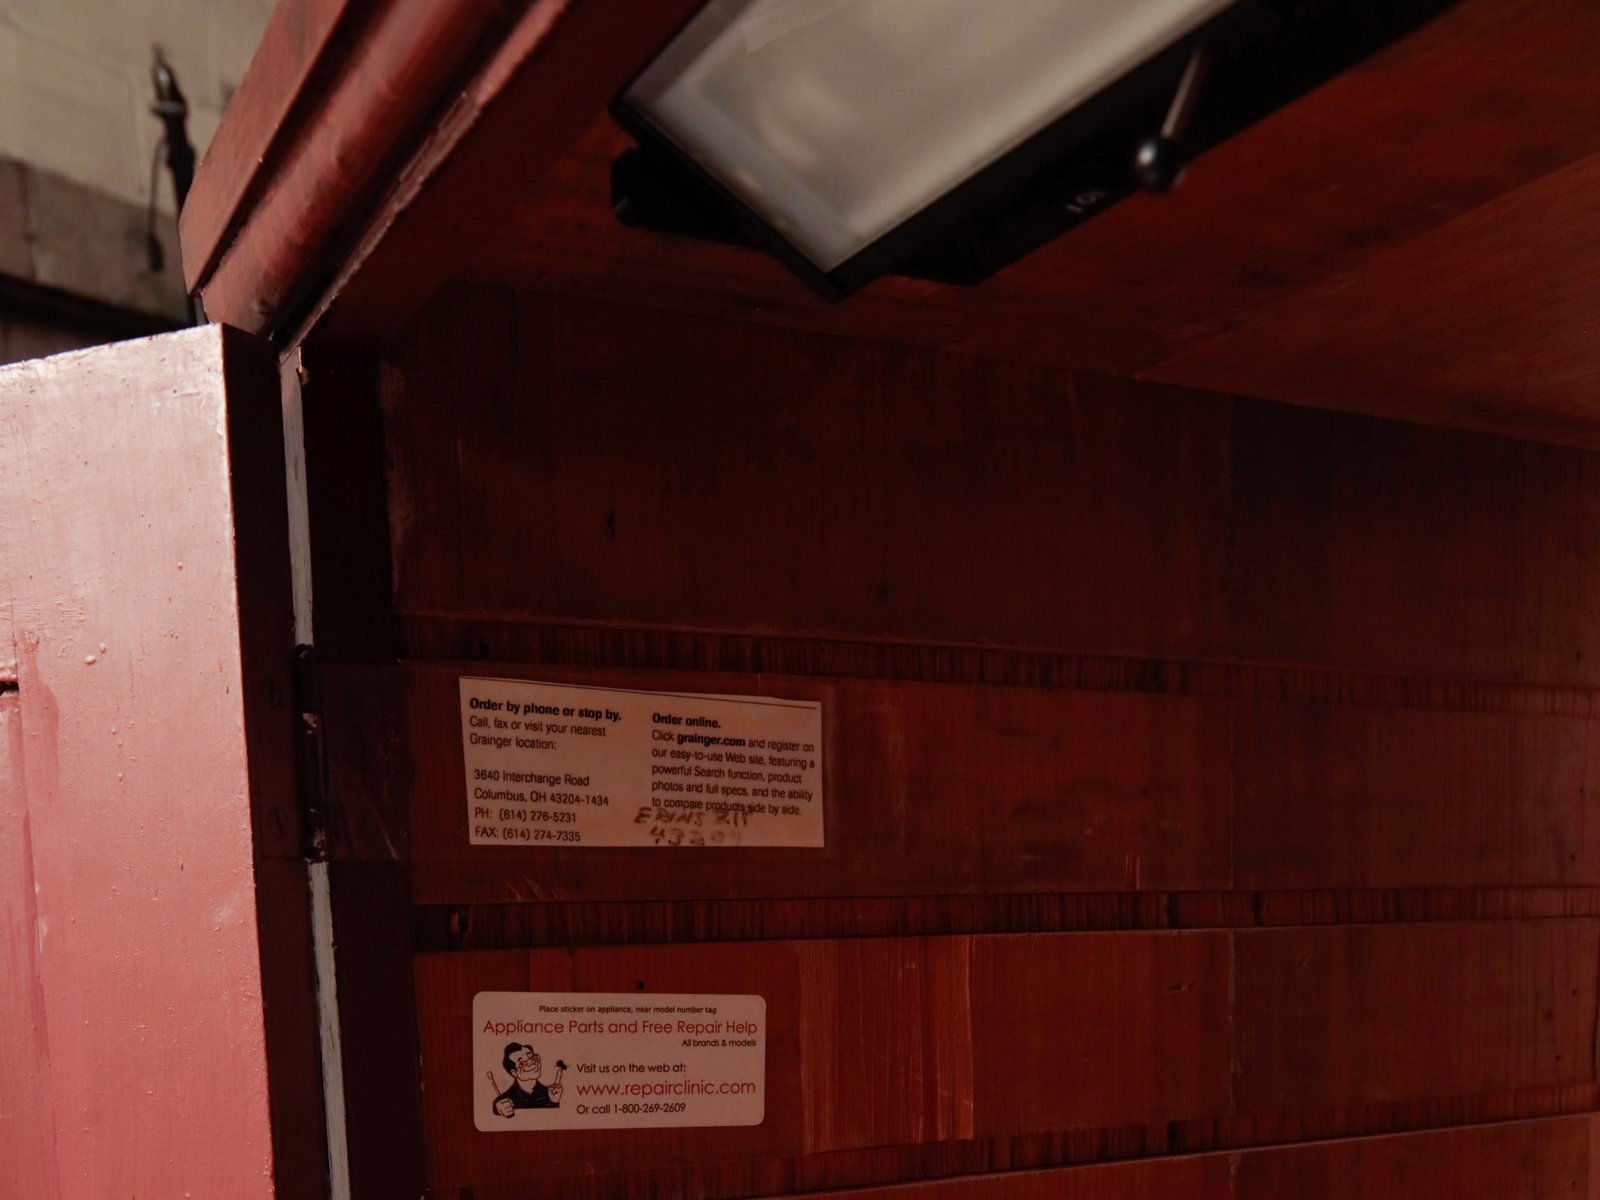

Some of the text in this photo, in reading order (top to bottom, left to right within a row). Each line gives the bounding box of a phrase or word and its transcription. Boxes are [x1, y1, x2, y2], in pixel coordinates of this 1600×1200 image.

[470, 698, 503, 710] Order
[507, 701, 520, 714] by
[524, 703, 559, 715] phone
[578, 709, 603, 721] stop
[605, 709, 621, 722] by.
[470, 716, 606, 736] Call, fax or visit your nearest
[653, 713, 721, 728] Order online.
[470, 734, 557, 750] Grainger location:
[652, 730, 814, 752] Click grainger.com and register on
[652, 749, 667, 757] our
[670, 750, 723, 762] easy-to-use
[726, 753, 745, 763] Web
[749, 755, 766, 766] site,
[769, 756, 807, 770] featuring
[474, 769, 589, 787] 3640 Interchange Road
[652, 765, 802, 783] powerful Search function, product
[475, 788, 609, 806] Columbus, OH 43204-1434
[652, 781, 813, 802] photos and full specs, and the ability
[475, 808, 576, 822] PH: (614) 276-5231
[652, 798, 661, 807] to
[664, 800, 703, 809] compare
[747, 803, 765, 814] side
[768, 805, 779, 816] by
[782, 806, 801, 814] side.
[476, 827, 580, 841] FAX: (614) 274-7335
[539, 1006, 558, 1014] Place
[560, 1005, 584, 1013] sticker
[597, 1006, 633, 1014] appliance,
[705, 1007, 716, 1015] tag
[483, 1021, 758, 1037] Appliance Parts and Free Repair Help
[693, 1039, 719, 1047] brands
[577, 1063, 686, 1073] Visit us on the web at:
[576, 1080, 755, 1098] www.repairclinic.com
[576, 1103, 686, 1114] Or call 1-800-269-2609
